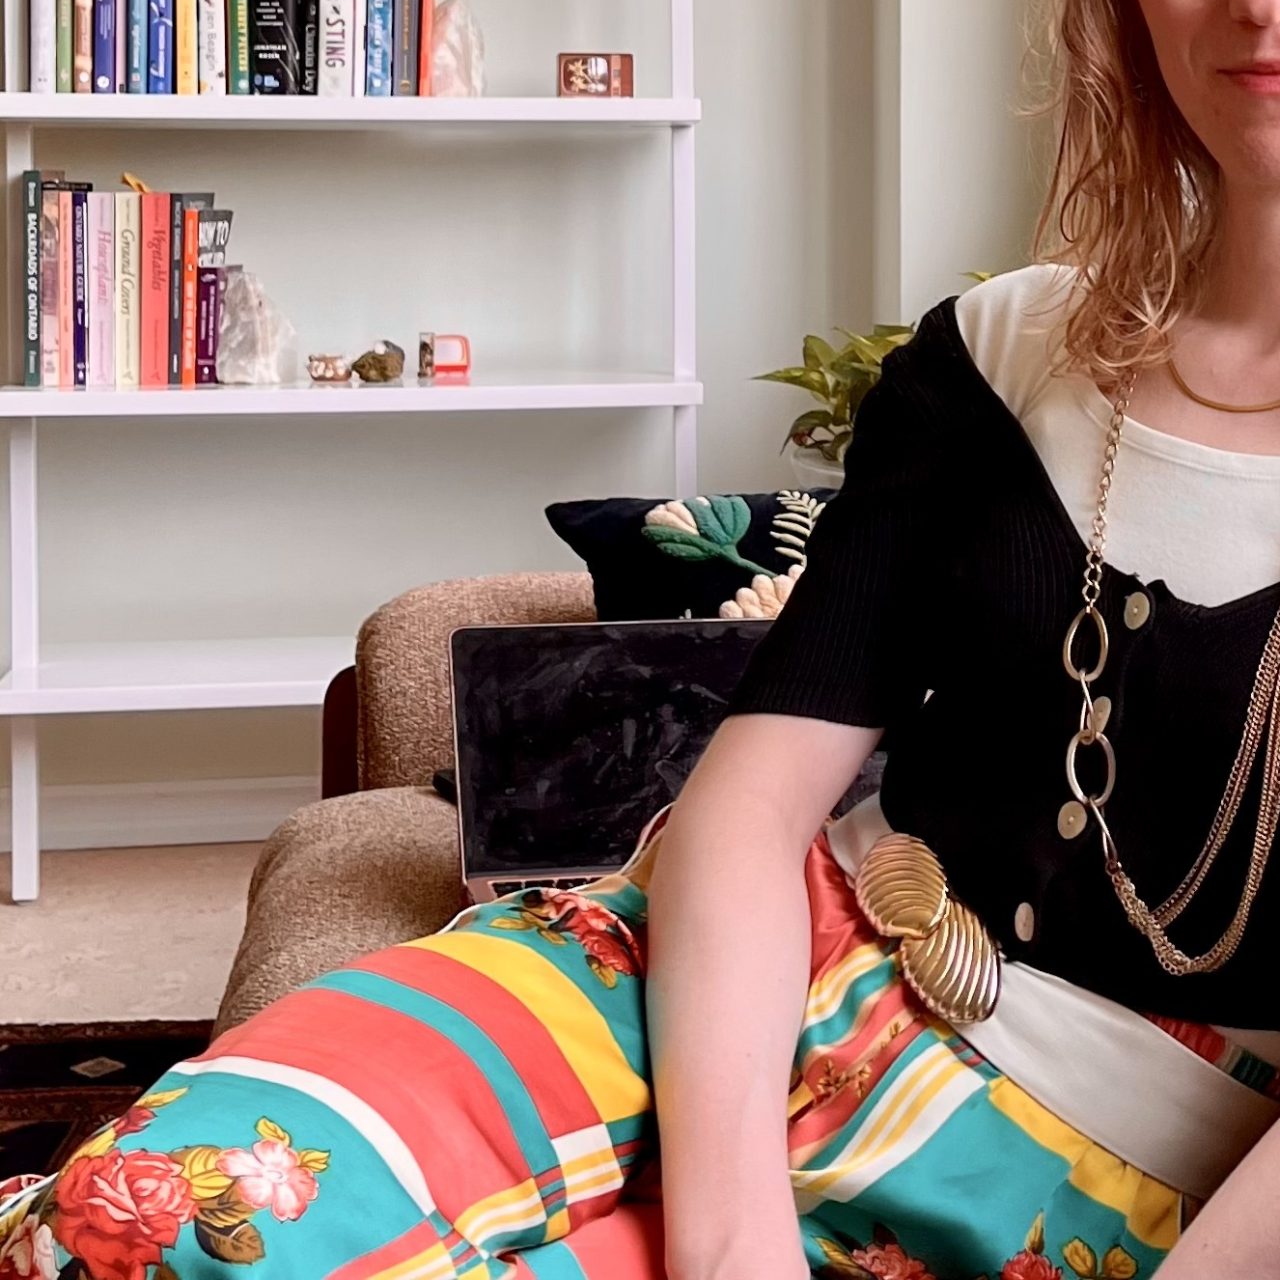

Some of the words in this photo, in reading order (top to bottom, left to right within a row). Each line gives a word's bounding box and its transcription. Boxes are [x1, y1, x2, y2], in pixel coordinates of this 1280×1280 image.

[305, 23, 316, 67] Claudia
[325, 17, 345, 68] STING
[302, 69, 316, 93] Dey
[27, 213, 38, 275] BACKROADS
[121, 228, 136, 276] Ground
[147, 228, 166, 291] Vegetables
[28, 277, 38, 292] OF
[121, 278, 135, 315] Covers
[28, 293, 39, 341] ONTARIO
